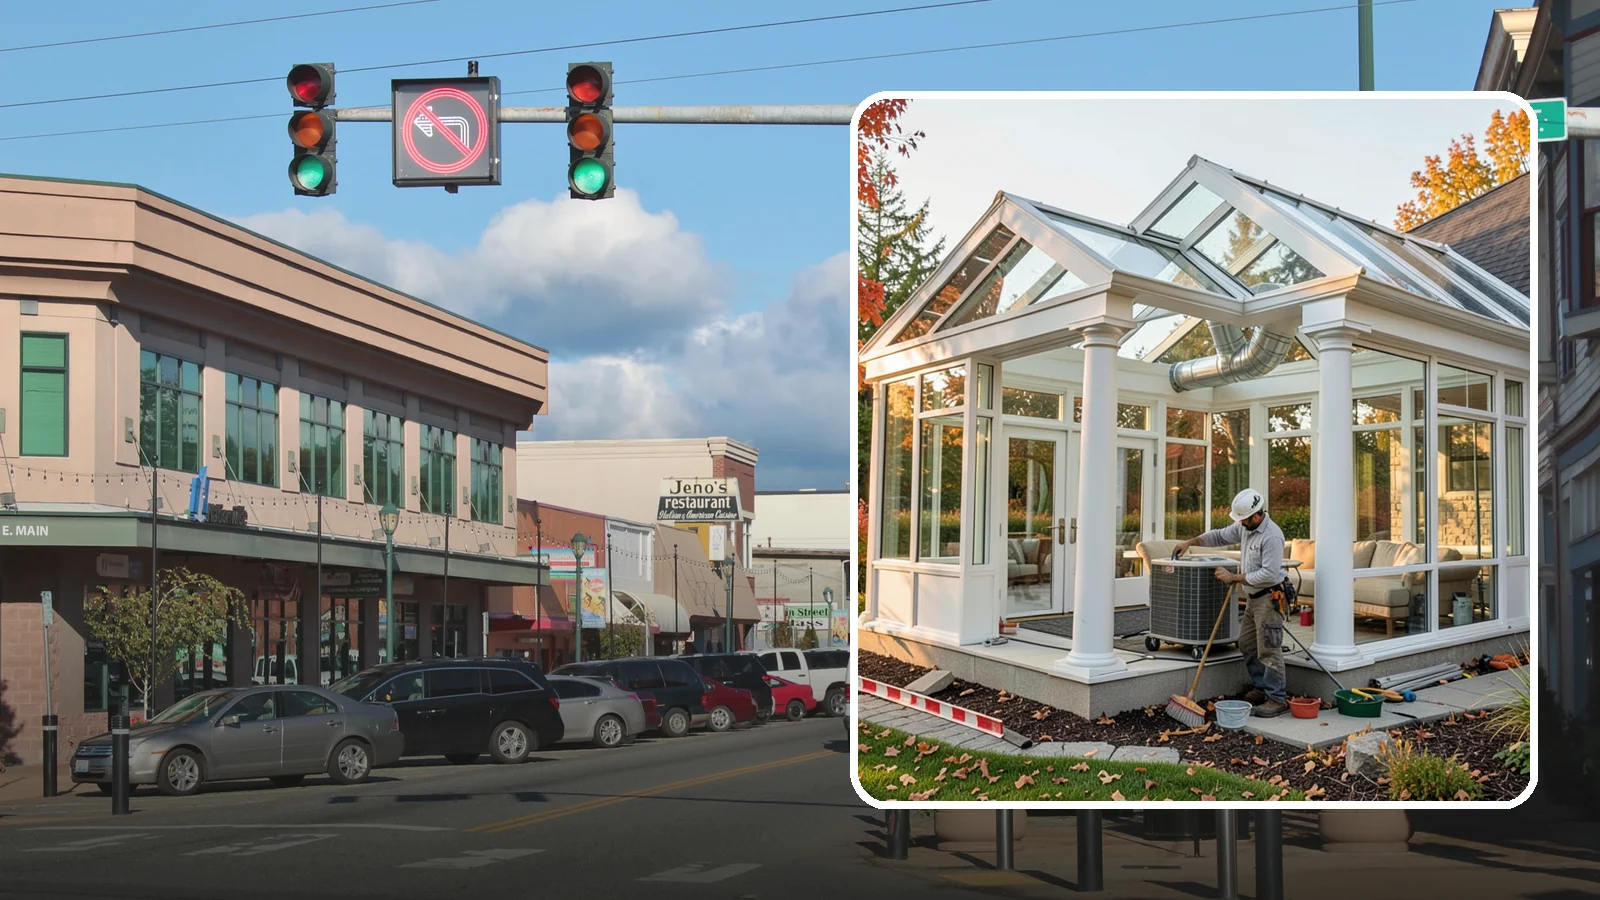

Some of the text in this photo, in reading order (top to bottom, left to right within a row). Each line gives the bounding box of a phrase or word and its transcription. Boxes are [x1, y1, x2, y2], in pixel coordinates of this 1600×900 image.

[669, 480, 727, 494] Jeno's
[664, 496, 731, 509] restaurant
[686, 509, 714, 519] American
[715, 509, 737, 519] Cuisine
[2, 525, 49, 536] E. MAIN
[797, 607, 828, 616] Street
